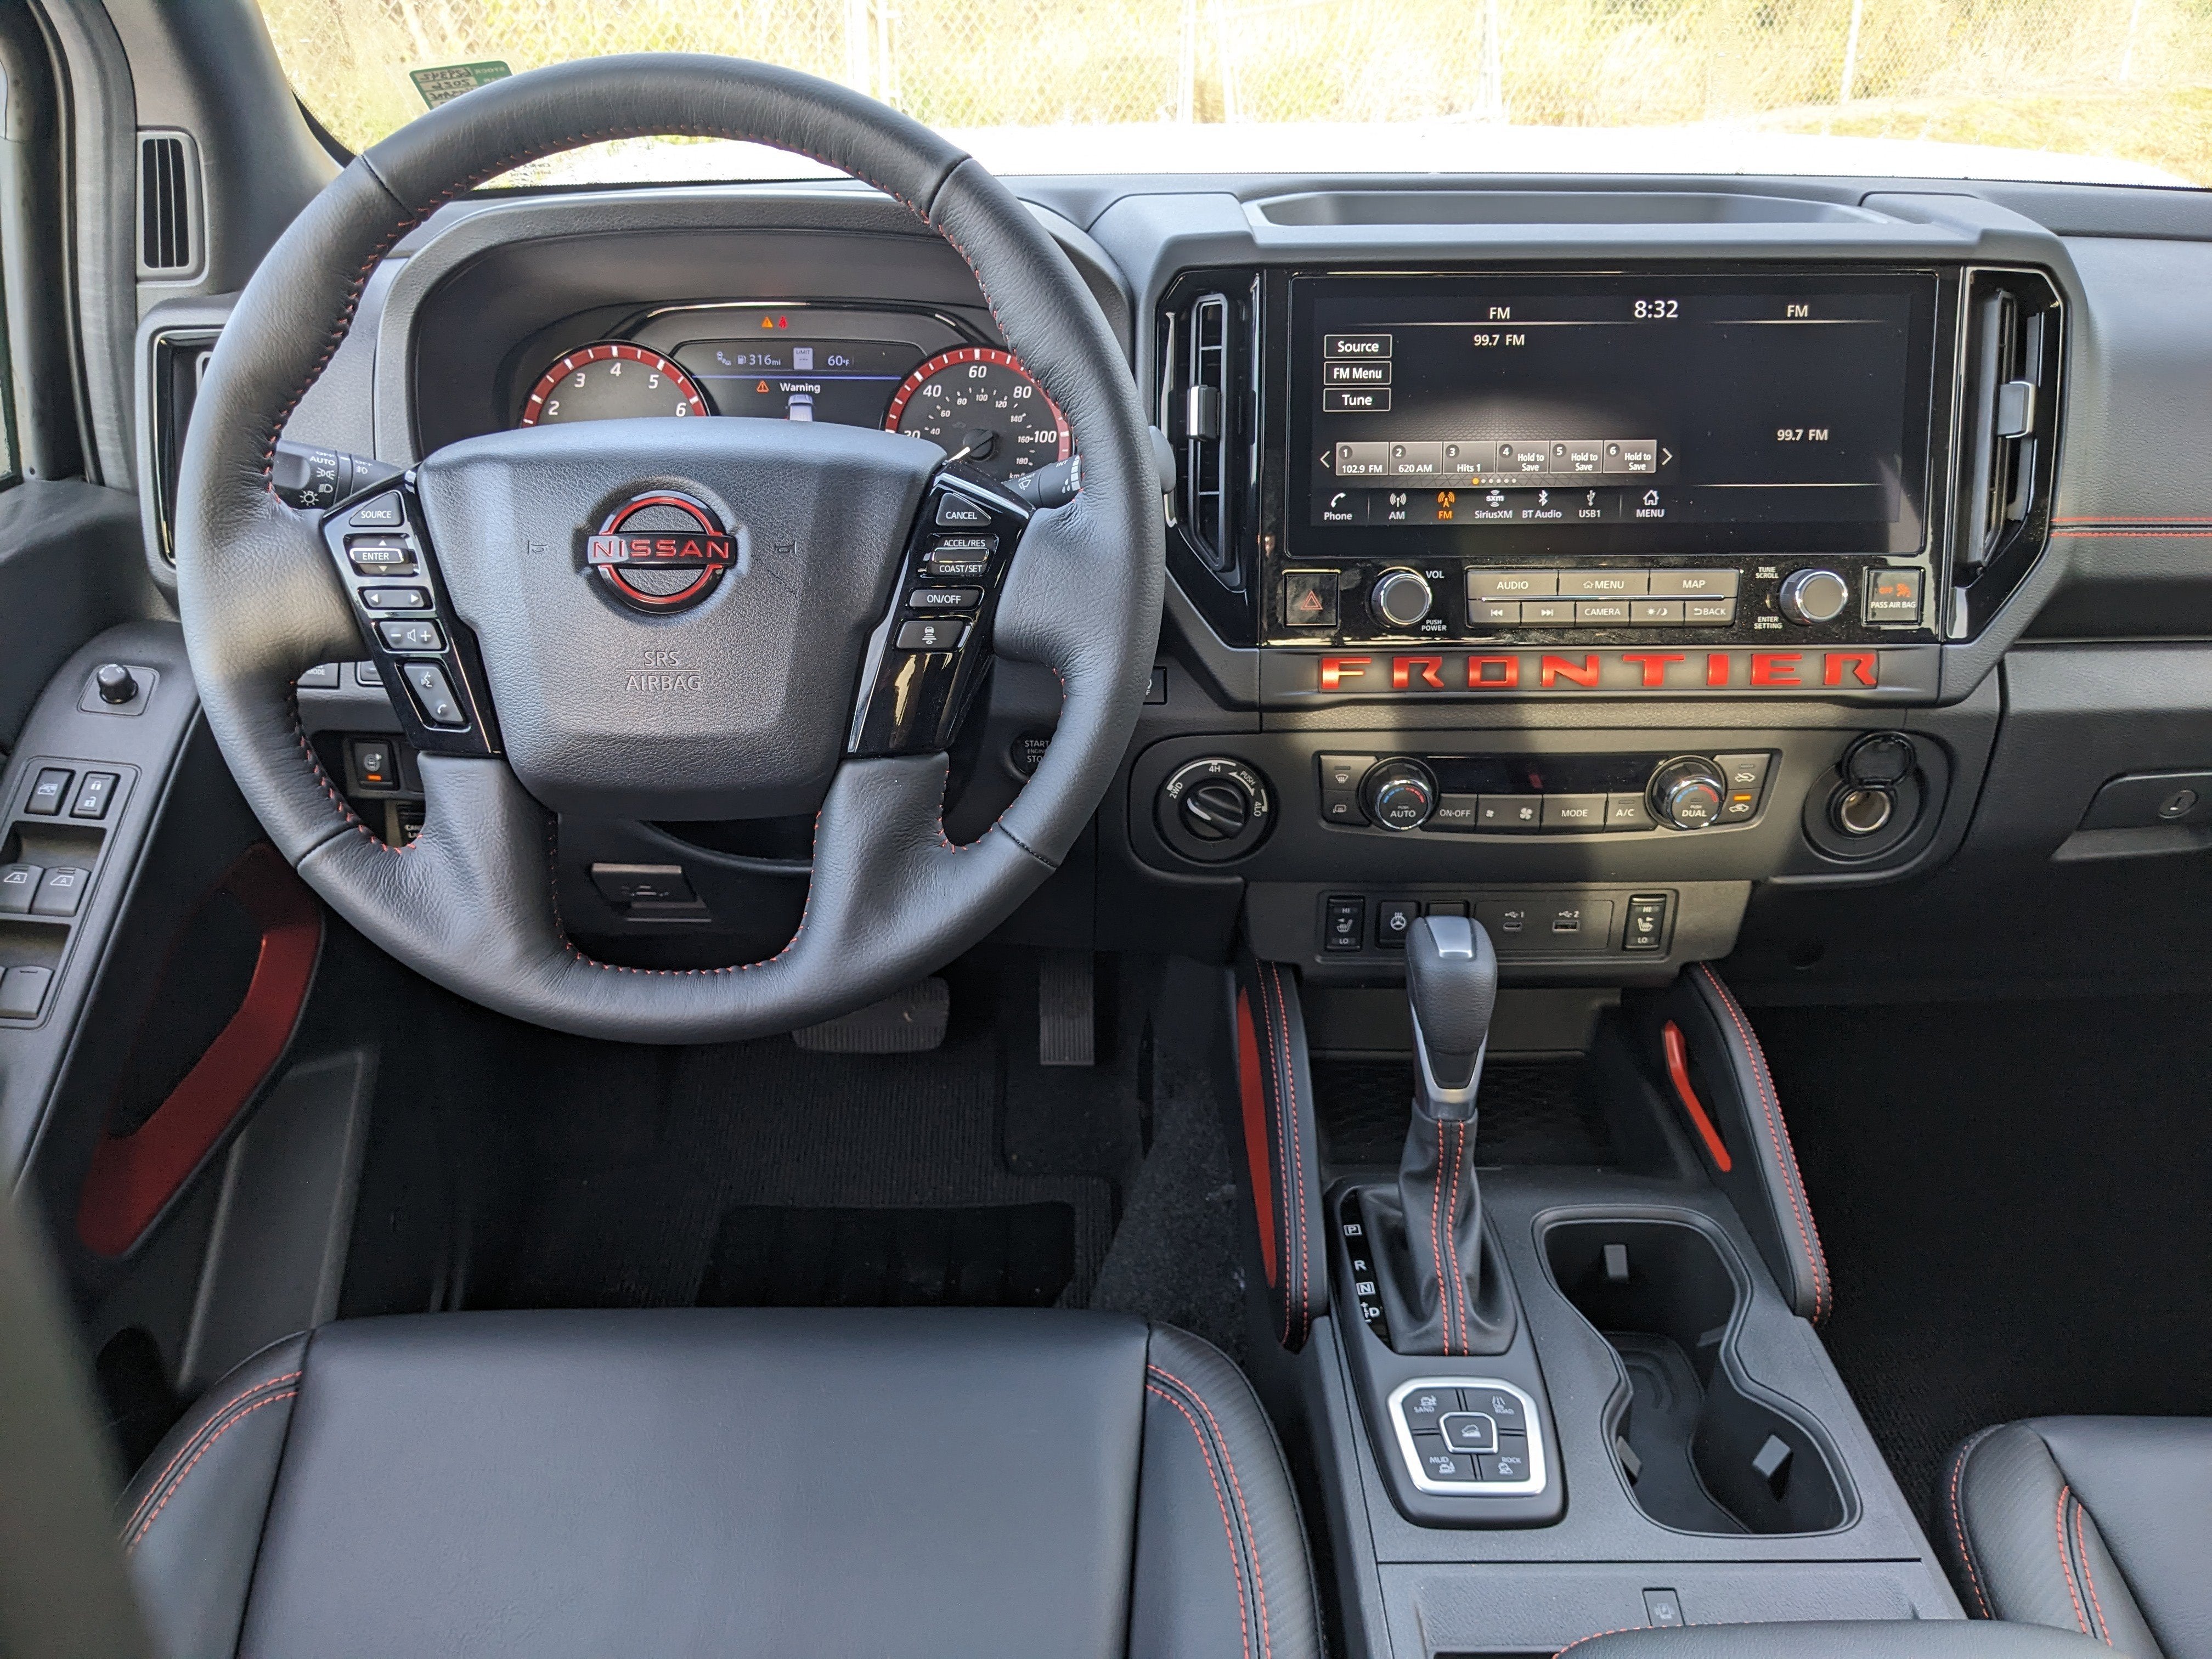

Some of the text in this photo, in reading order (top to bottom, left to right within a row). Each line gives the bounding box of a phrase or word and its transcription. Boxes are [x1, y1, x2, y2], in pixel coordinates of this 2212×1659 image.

[1489, 307, 1510, 320] FM
[1634, 300, 1679, 318] 8:32
[1787, 304, 1809, 318] FM
[1474, 334, 1525, 346] 99.7 FM
[1338, 341, 1379, 353] Source
[749, 354, 771, 365] 316
[610, 362, 621, 377] 4
[969, 365, 987, 378] 60
[1334, 368, 1382, 380] FM Menu
[574, 373, 585, 388] 3
[648, 374, 659, 389] 5
[780, 382, 821, 393] Warning
[923, 385, 941, 397] 40
[1013, 386, 1031, 398] 80
[1342, 394, 1373, 406] Tune
[548, 400, 560, 415] 2
[675, 402, 687, 417] 6
[1034, 430, 1057, 443] 100
[1777, 429, 1828, 441] 99.7 FM
[1344, 449, 1348, 457] 1
[1396, 448, 1402, 457] 2
[1449, 448, 1456, 456] 3
[1503, 447, 1509, 456] 4
[1557, 447, 1563, 456] 5
[1610, 447, 1616, 455] 6
[309, 456, 336, 466] AUTO
[1517, 454, 1534, 462] Hold
[1571, 453, 1588, 461] Hold
[1624, 453, 1641, 461] Hold
[1056, 460, 1069, 468] INT
[1417, 464, 1432, 472] AM
[1457, 464, 1474, 472] Hits
[1522, 464, 1539, 472] Save
[1575, 463, 1593, 471] Save
[1628, 462, 1646, 471] Save
[1018, 472, 1036, 482] FRONT
[360, 510, 392, 519] SOURCE
[946, 511, 978, 520] CANCEL
[1324, 512, 1352, 521] Phone
[1389, 511, 1405, 520] AM
[1438, 511, 1453, 519] FM
[1475, 510, 1513, 519] SiriusXM
[1522, 510, 1562, 518] BT Audio
[1579, 510, 1601, 518] USB1
[1636, 509, 1664, 517] MENU
[944, 539, 986, 548] ACCEL/RES
[593, 539, 730, 559] NISSAN
[362, 552, 390, 560] ENTER
[939, 565, 983, 573] COAST/SET
[1426, 571, 1444, 579] VOL
[1497, 581, 1529, 590] AUDIO
[1595, 581, 1624, 589] MENU
[927, 595, 962, 604] ON/OFF
[644, 651, 679, 667] SRS
[1322, 654, 1878, 689] FRONTIER
[625, 675, 702, 691] AIRBAG
[1240, 770, 1256, 786] PUSH
[1169, 782, 1183, 799] 2WD
[1253, 800, 1262, 817] 4LO
[1561, 809, 1588, 817] MODE
[1616, 809, 1634, 817] A/C
[1681, 809, 1707, 817] DUAL
[1354, 1260, 1367, 1271] R
[1360, 1284, 1372, 1293] N
[1369, 1307, 1380, 1317] D
